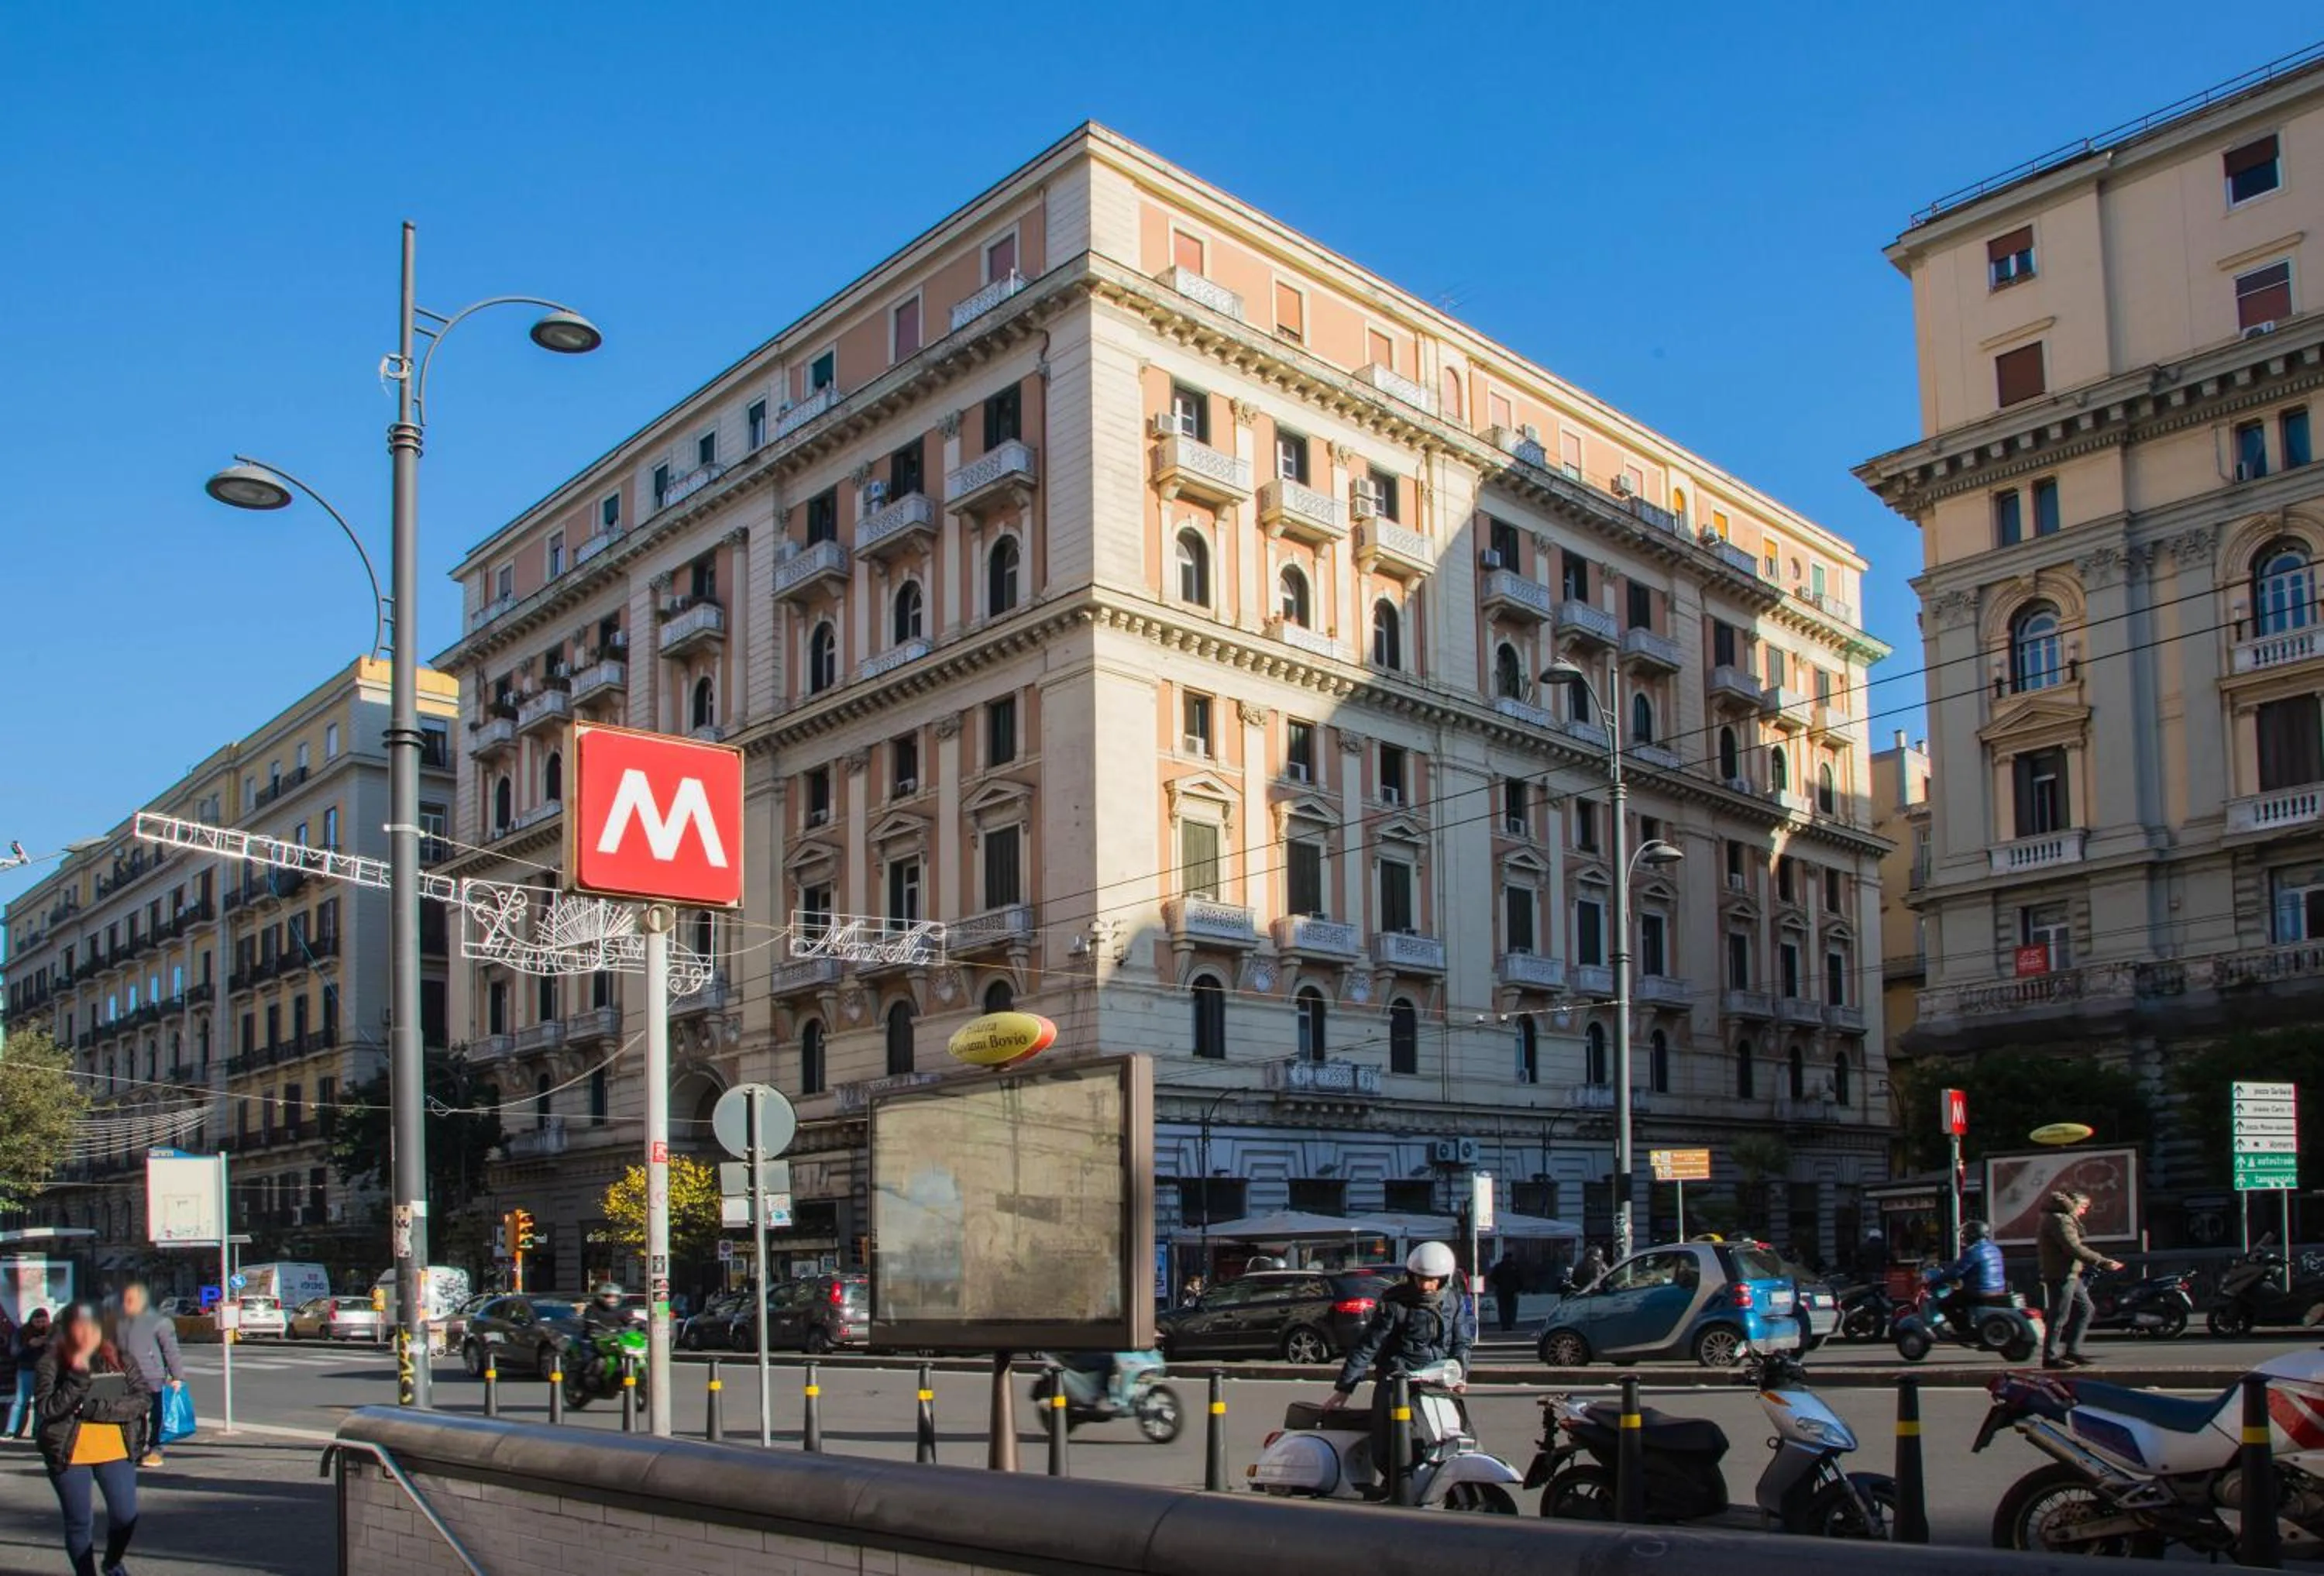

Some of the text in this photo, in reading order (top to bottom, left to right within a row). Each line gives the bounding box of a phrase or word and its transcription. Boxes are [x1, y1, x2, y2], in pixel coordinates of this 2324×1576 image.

[596, 768, 729, 869] M
[988, 1031, 1028, 1048] Bovio
[1952, 1100, 1965, 1124] M
